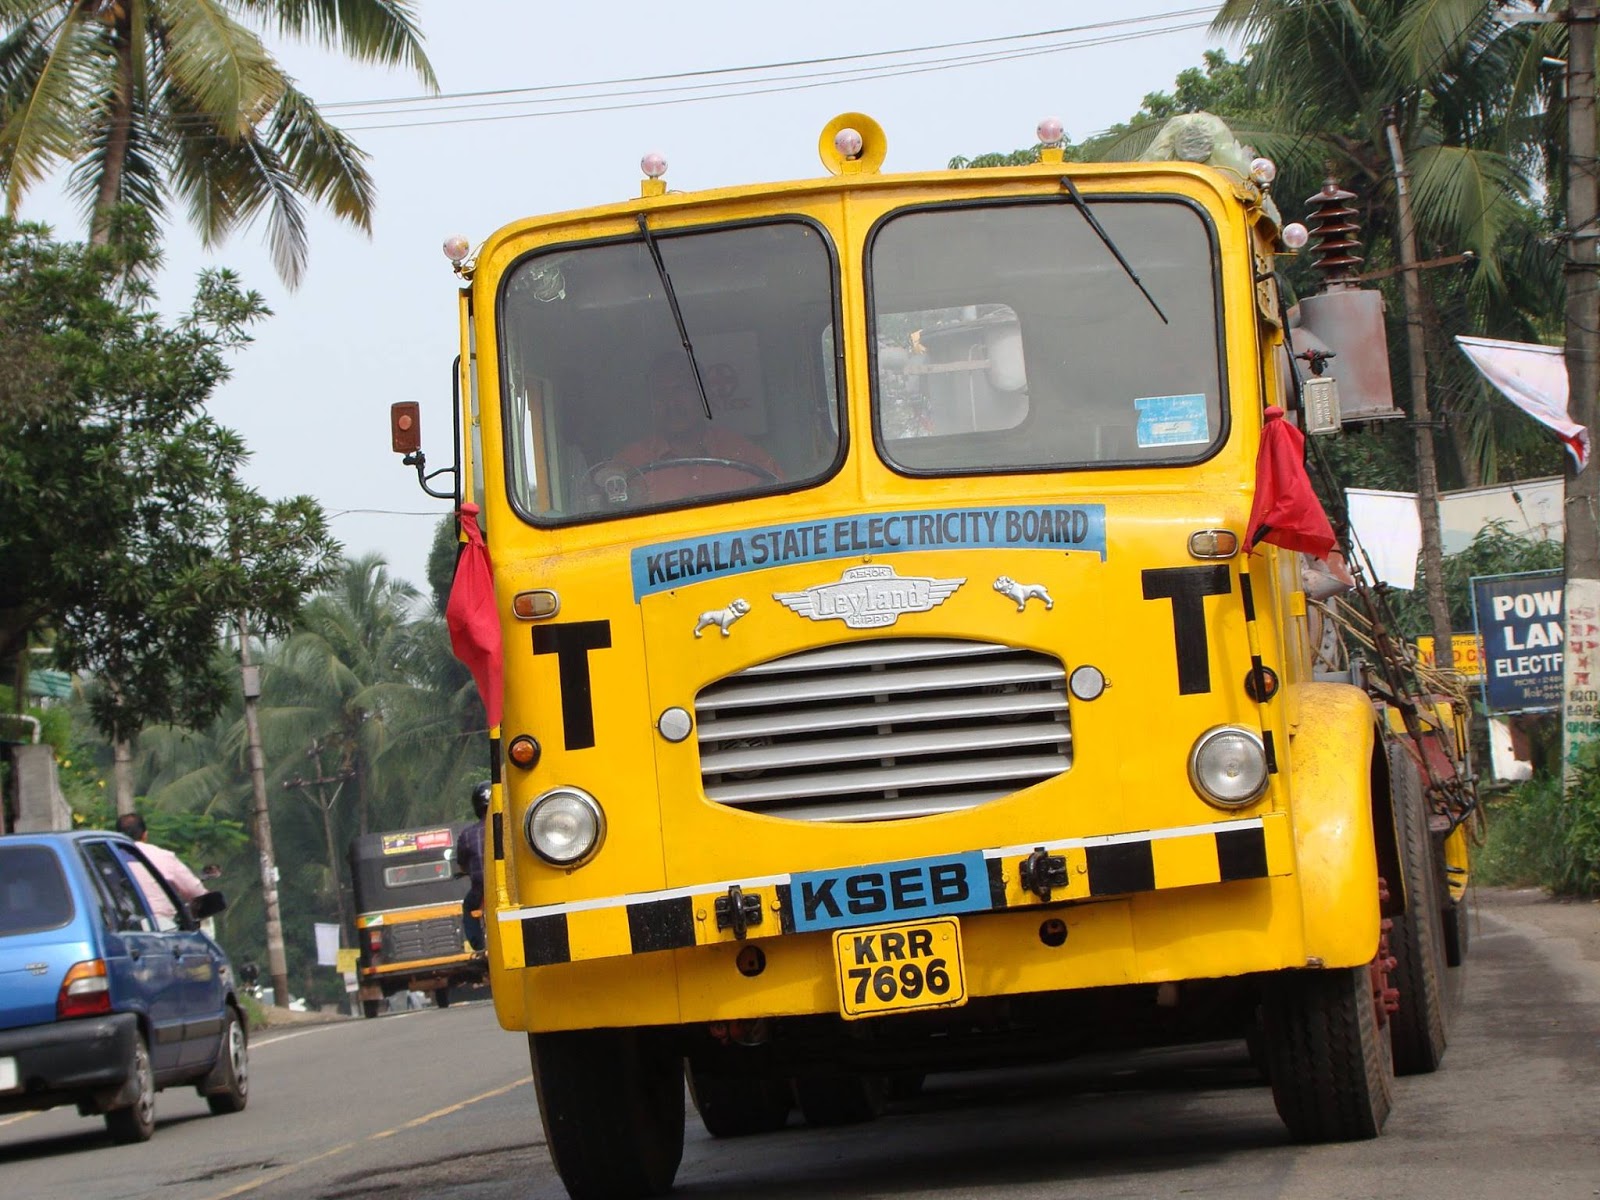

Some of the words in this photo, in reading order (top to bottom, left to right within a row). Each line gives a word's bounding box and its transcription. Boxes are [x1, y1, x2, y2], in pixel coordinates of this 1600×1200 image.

[647, 543, 746, 586] KERALA
[753, 523, 828, 565] STATE
[834, 510, 1001, 552] ELECTRICITY
[1005, 509, 1088, 544] BOARD
[817, 582, 922, 617] Leyland
[1141, 564, 1232, 696] T
[531, 619, 612, 751] T
[801, 862, 970, 921] KSEB
[853, 929, 934, 965] KRR
[848, 958, 951, 1005] 7696
